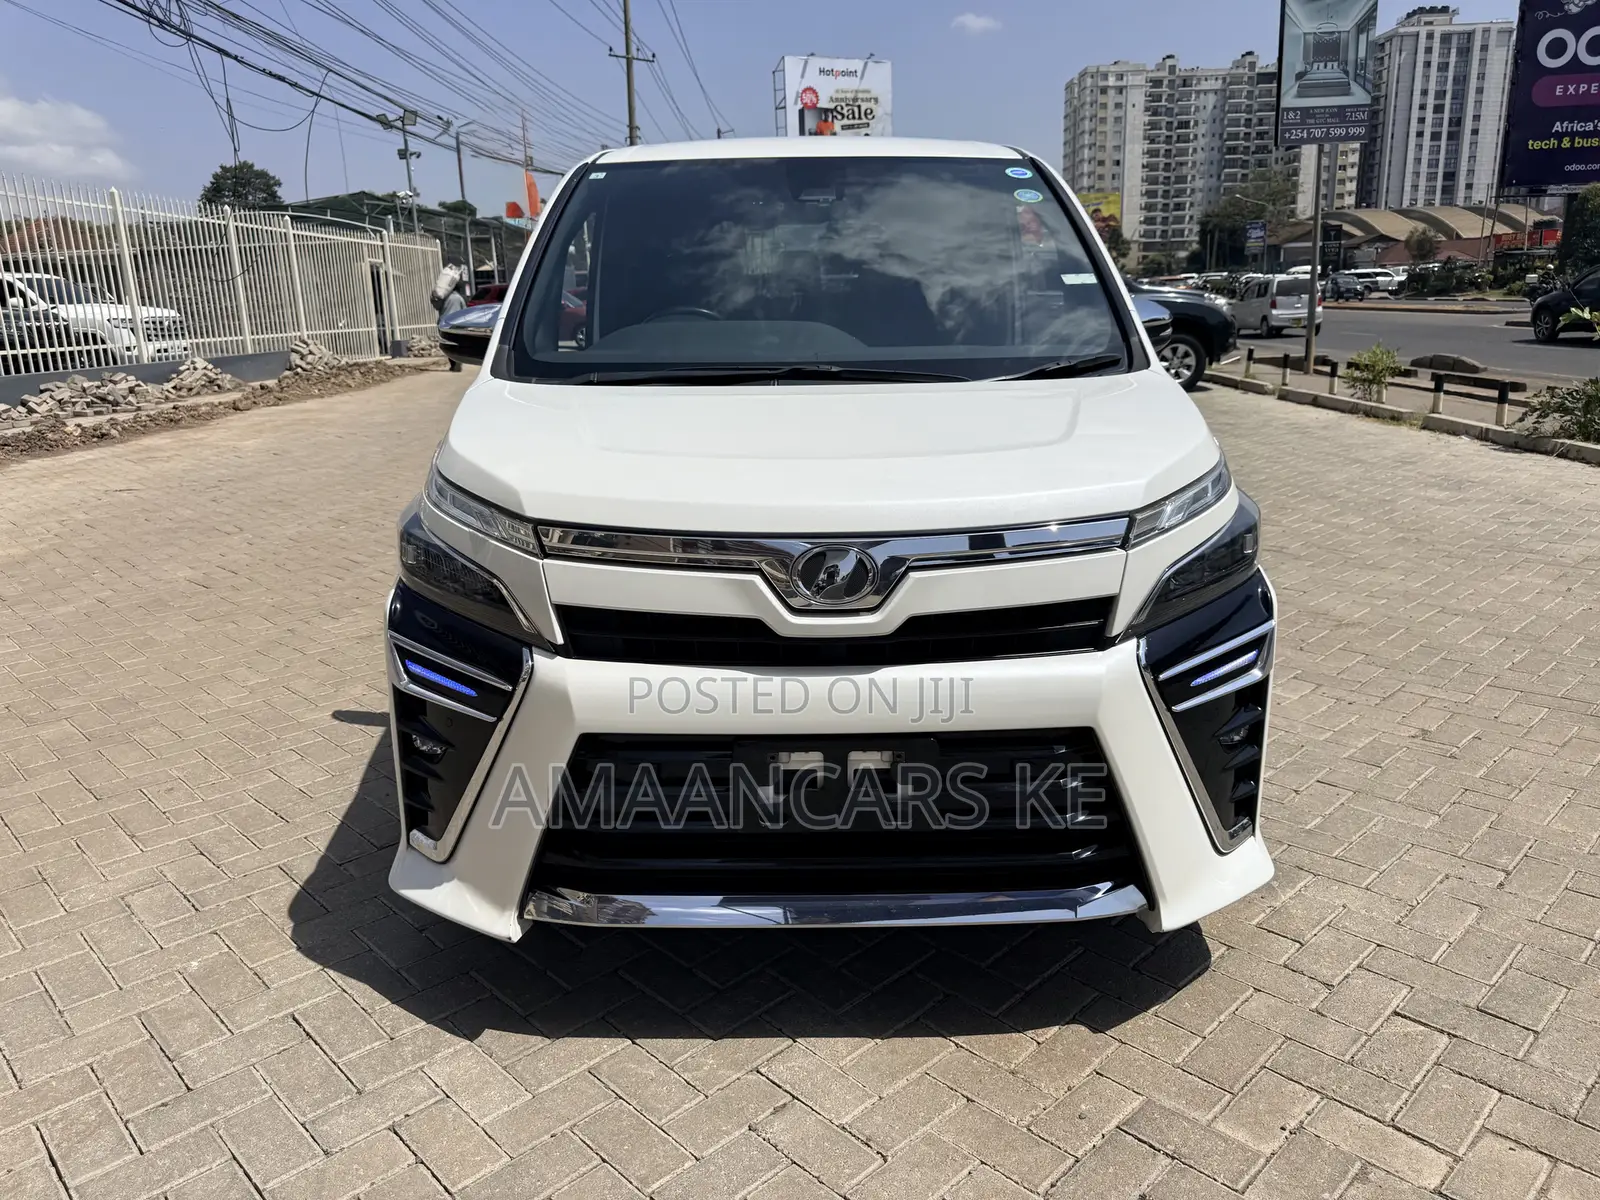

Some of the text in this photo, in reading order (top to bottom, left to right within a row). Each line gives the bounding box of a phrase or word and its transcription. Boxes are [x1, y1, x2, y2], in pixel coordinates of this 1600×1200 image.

[818, 67, 858, 80] Hotpoint
[834, 103, 875, 121] Sale
[1283, 110, 1301, 120] 1&2
[1284, 126, 1365, 139] +254 707 599 999
[1528, 138, 1558, 149] tech
[1561, 137, 1571, 148] &
